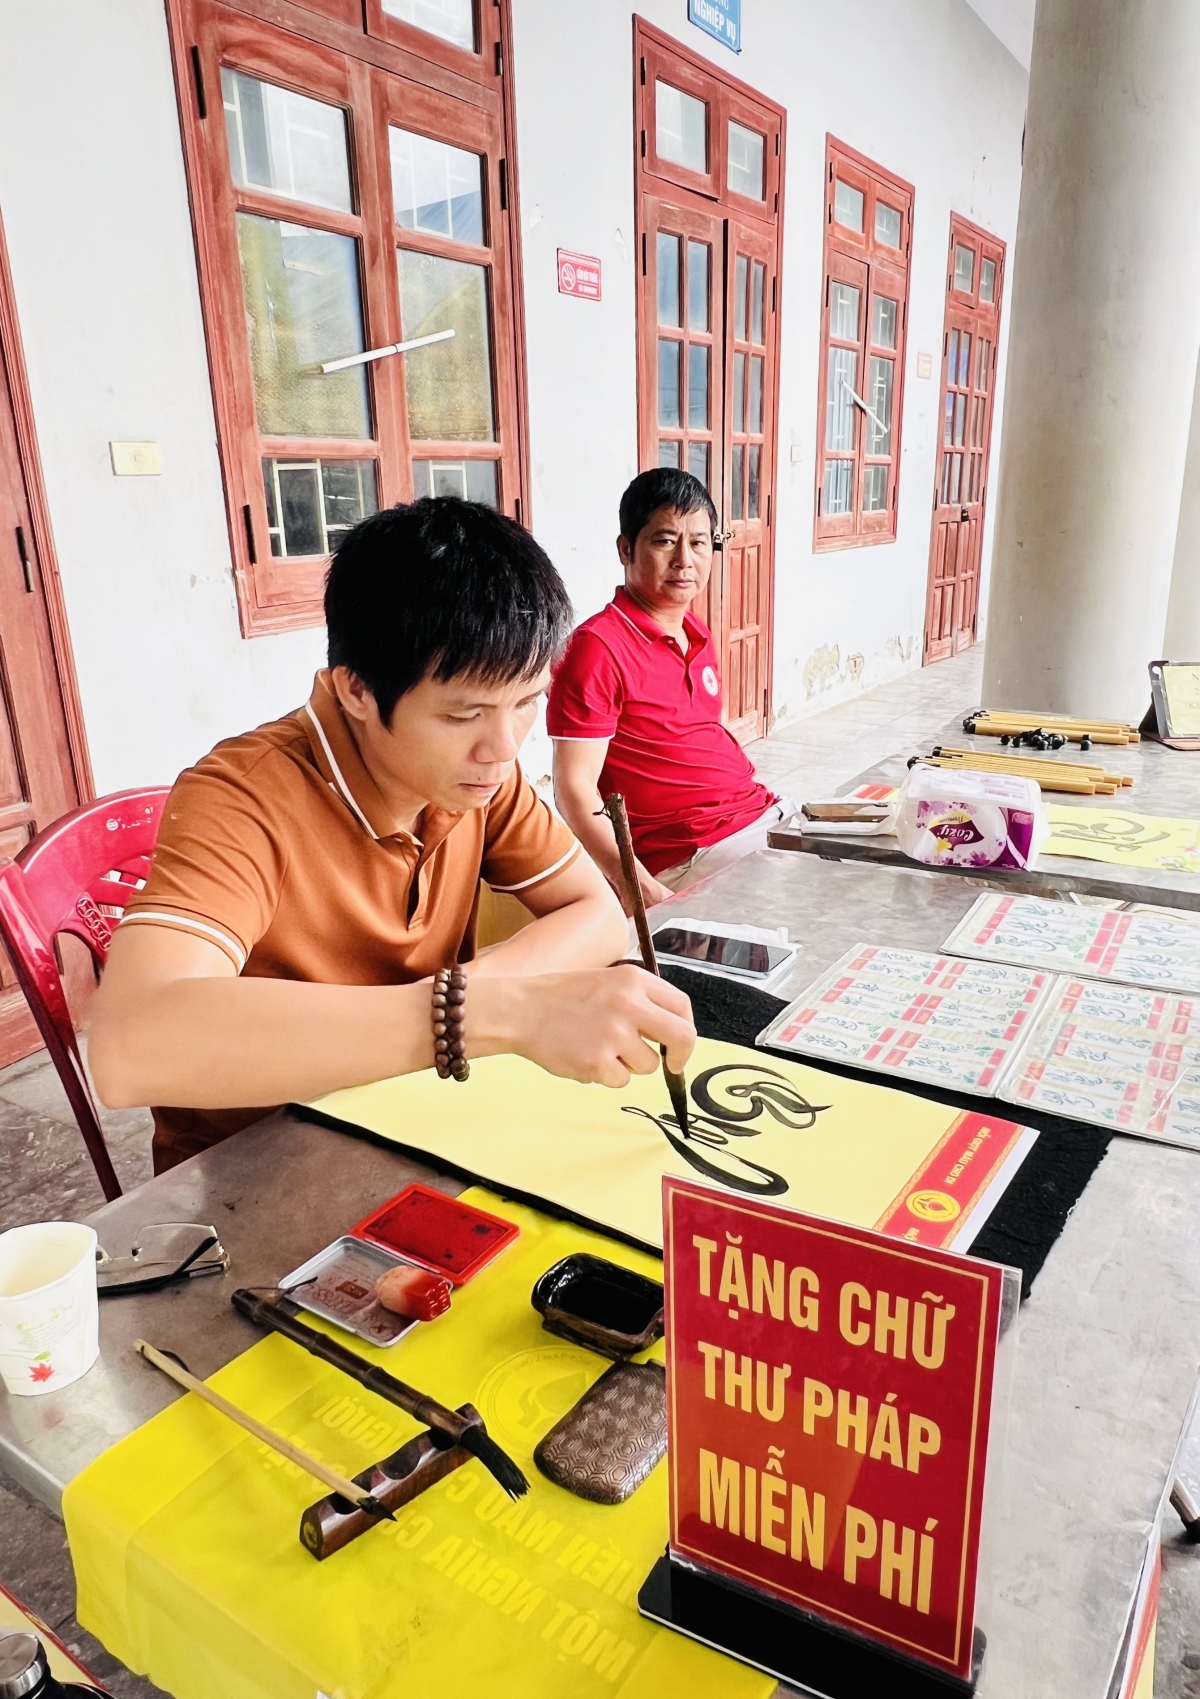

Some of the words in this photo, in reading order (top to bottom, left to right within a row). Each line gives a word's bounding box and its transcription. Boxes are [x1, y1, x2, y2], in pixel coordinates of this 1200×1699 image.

[694, 0, 724, 33] NGHIỆP
[726, 18, 736, 45] VỤ
[939, 824, 974, 842] Cozy
[693, 1232, 819, 1332] TẶNG
[838, 1281, 955, 1369] CHỮ
[697, 1340, 790, 1422] THƯ
[803, 1378, 941, 1474] PHÁP
[699, 1445, 825, 1571] MIỄN
[843, 1505, 938, 1614] PHÍ
